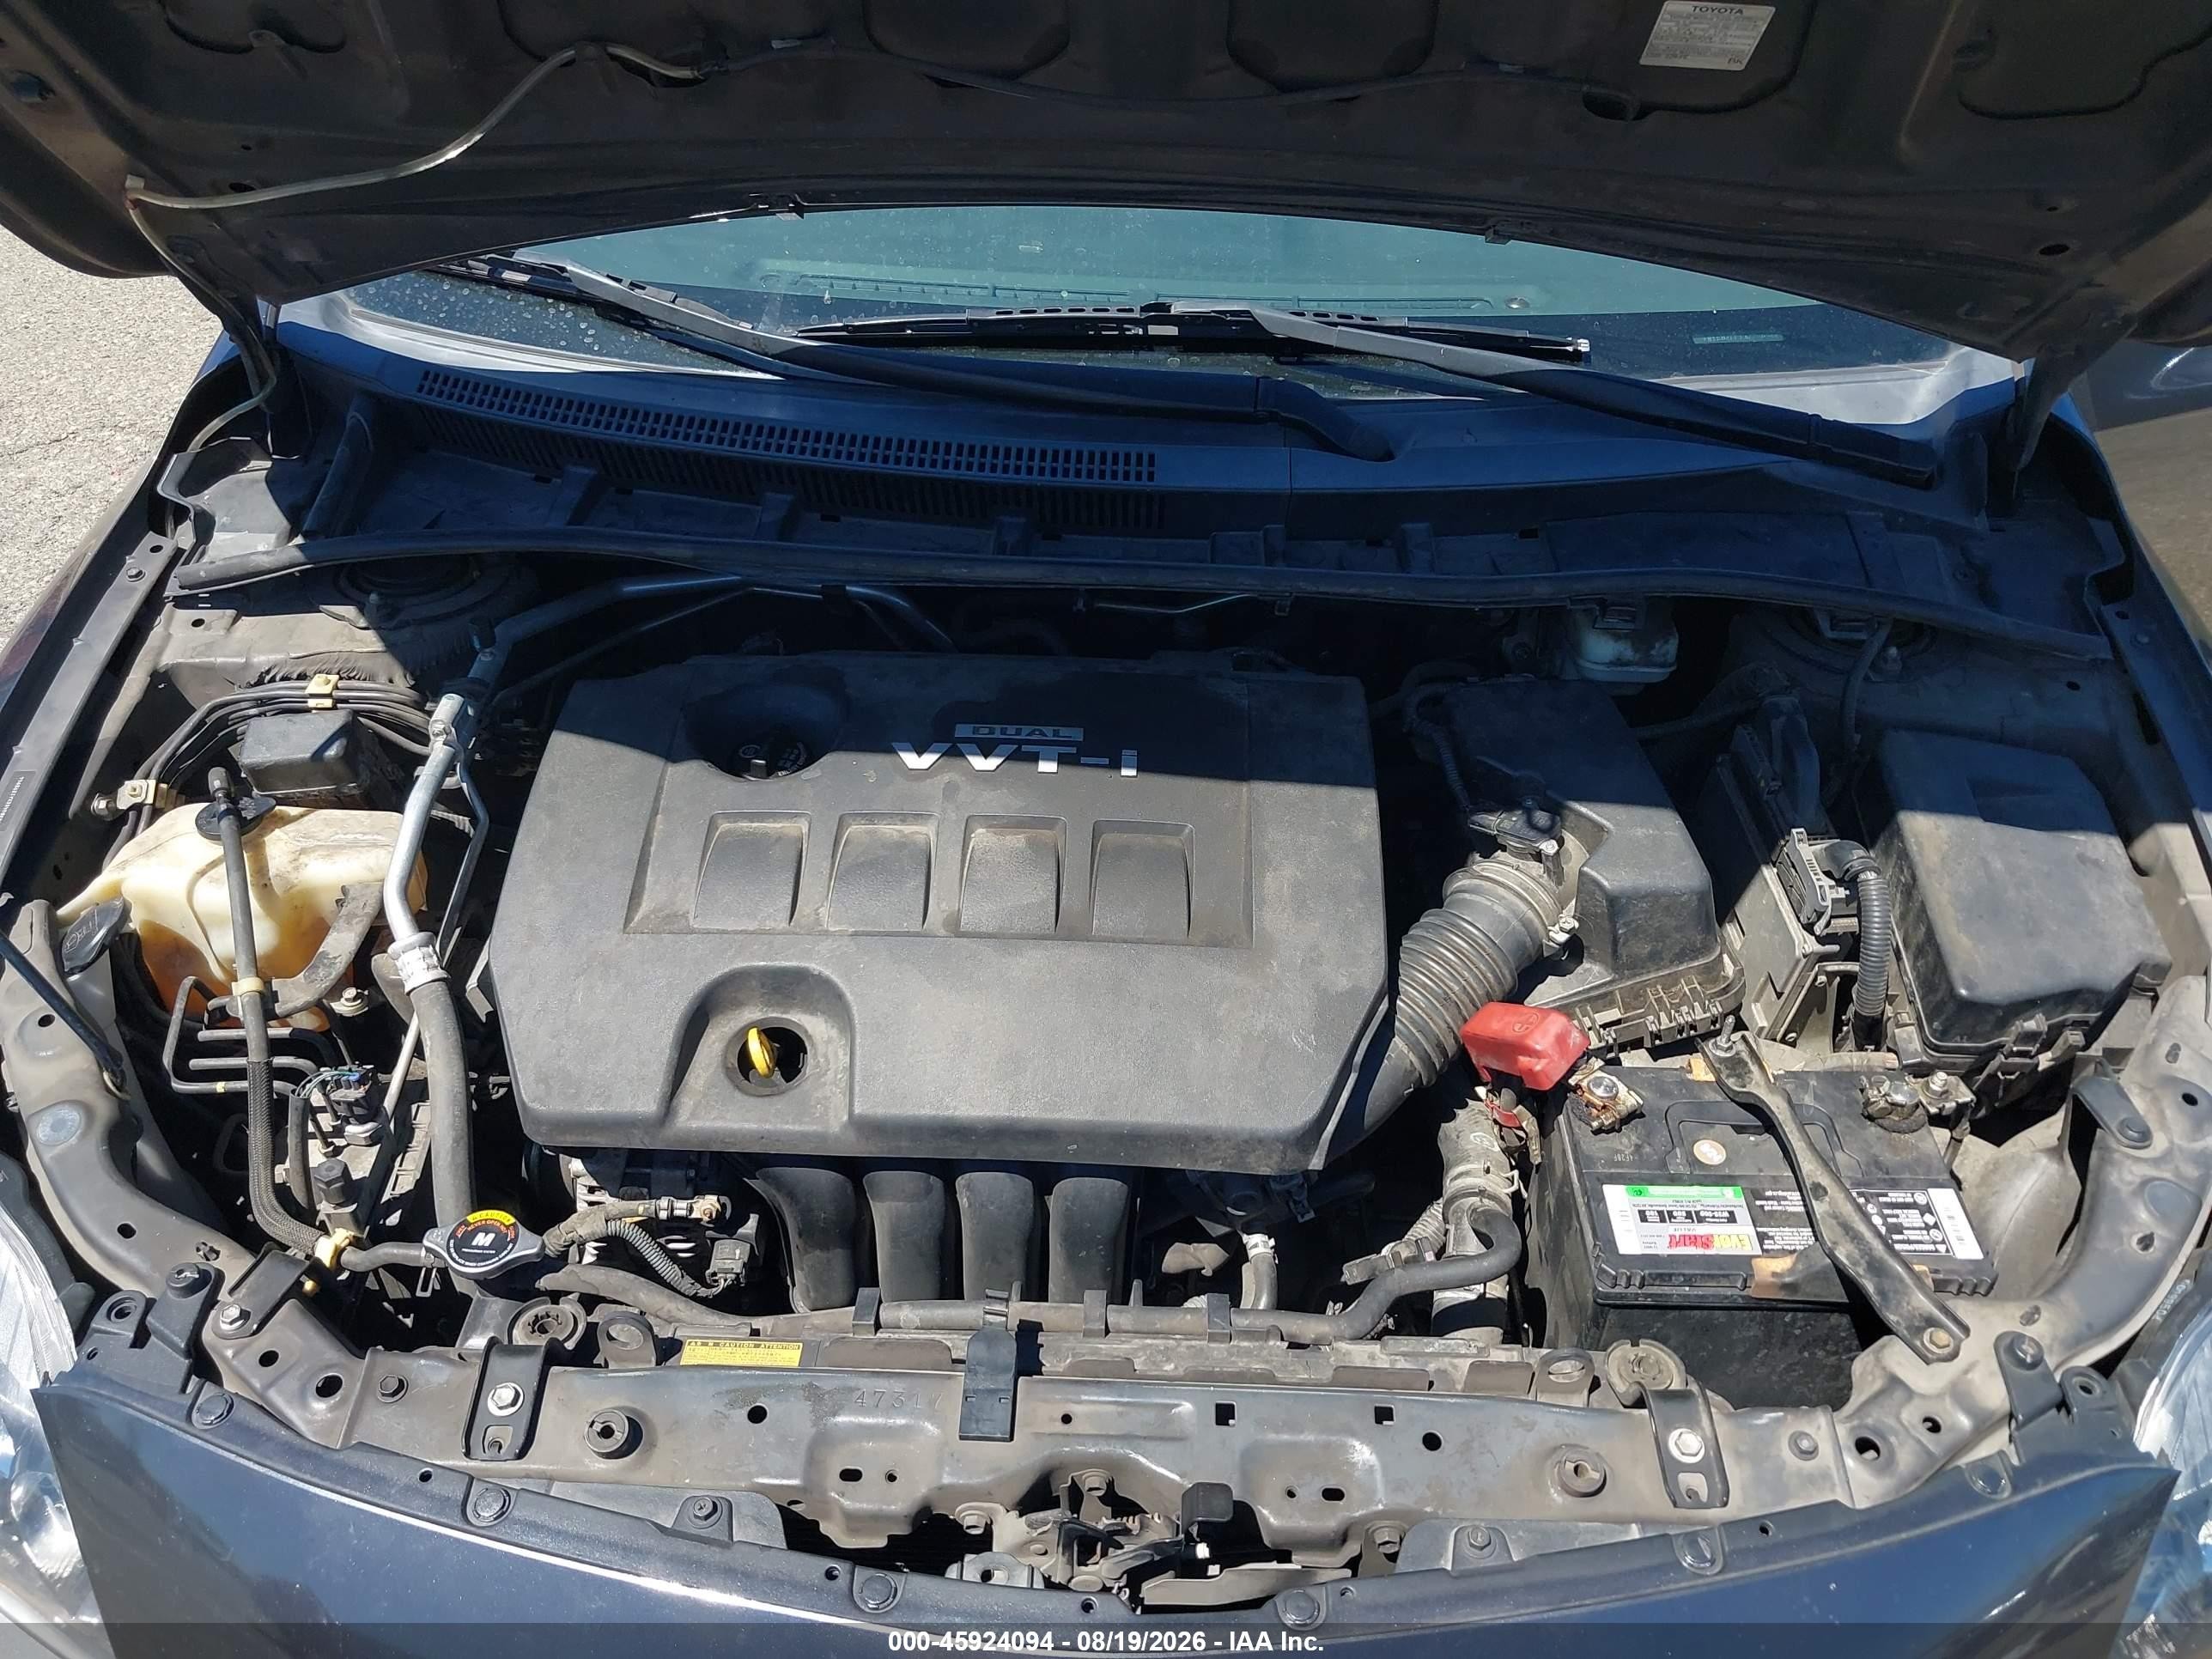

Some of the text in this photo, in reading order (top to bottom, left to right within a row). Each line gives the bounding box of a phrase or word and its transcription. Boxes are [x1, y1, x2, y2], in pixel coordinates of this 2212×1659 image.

[1692, 5, 1743, 15] TOYOTA
[972, 726, 1073, 738] DUAL
[891, 742, 1138, 777] VVT-i
[478, 1212, 512, 1223] CAUTION
[471, 1231, 496, 1247] M
